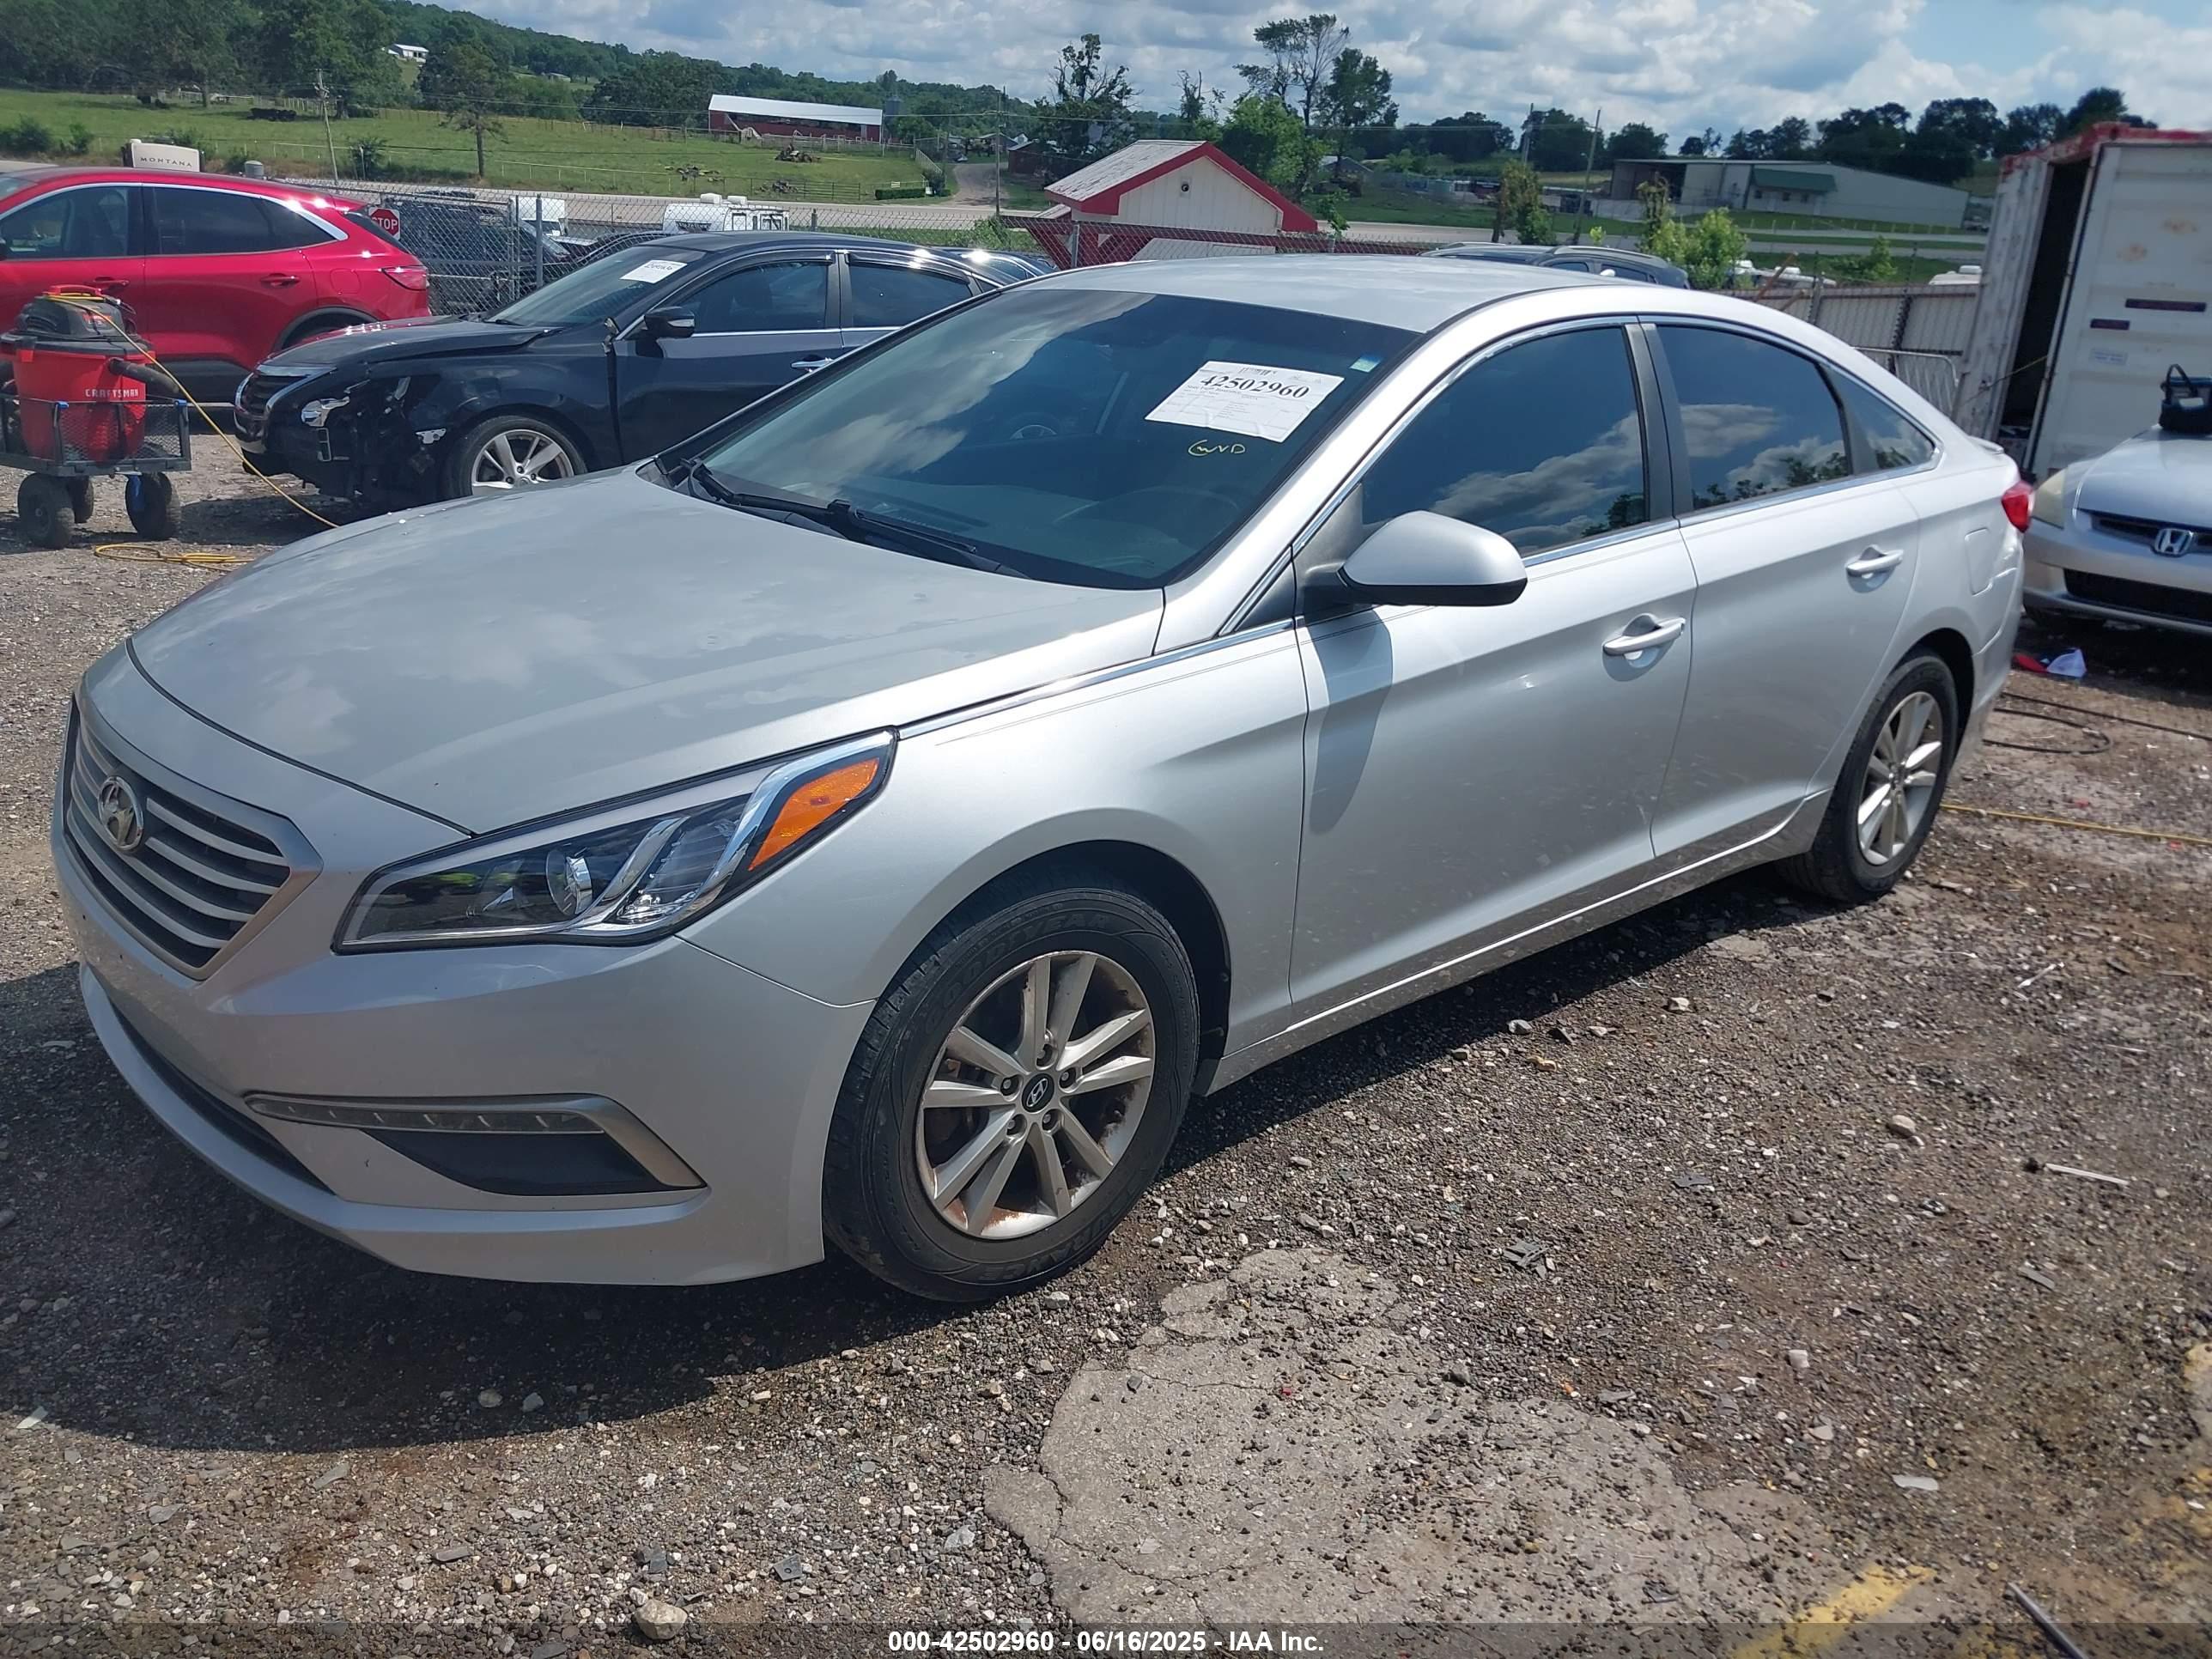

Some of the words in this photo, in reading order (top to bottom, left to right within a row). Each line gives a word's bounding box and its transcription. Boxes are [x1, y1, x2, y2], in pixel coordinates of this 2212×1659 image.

[140, 157, 192, 167] MONTANA
[1200, 375, 1310, 398] 42502960
[85, 388, 139, 398] CRAFTSMAN
